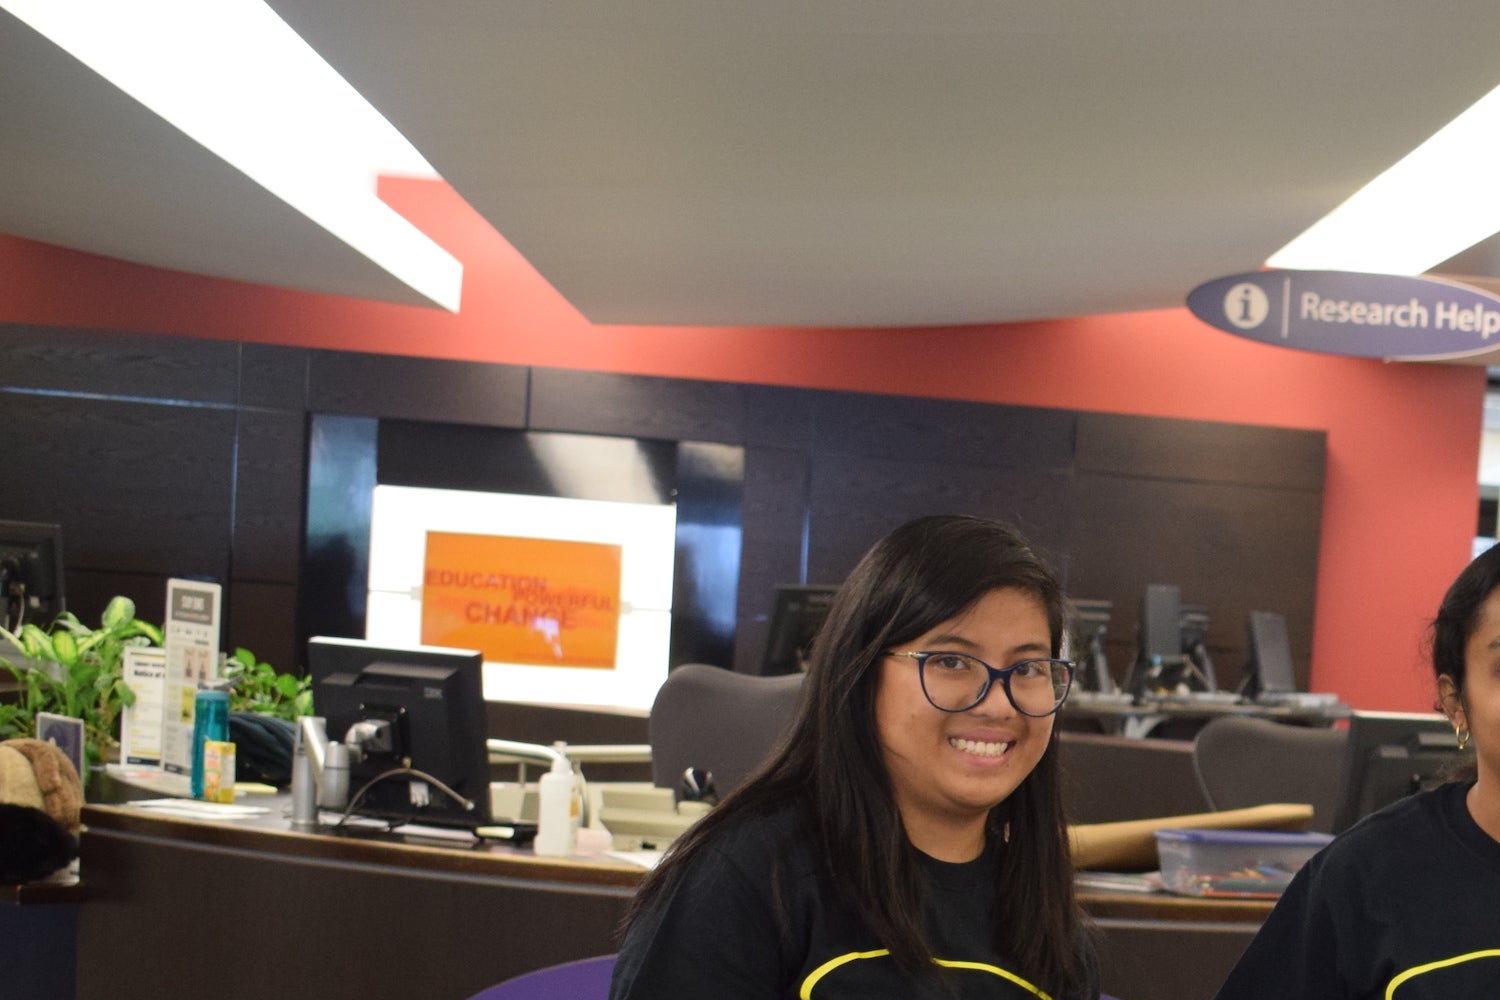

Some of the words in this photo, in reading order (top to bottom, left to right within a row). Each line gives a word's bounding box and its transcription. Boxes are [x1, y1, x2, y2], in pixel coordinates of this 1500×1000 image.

[1301, 292, 1428, 328] Research
[425, 569, 548, 592] EDUCATION
[464, 601, 578, 630] CHANGE
